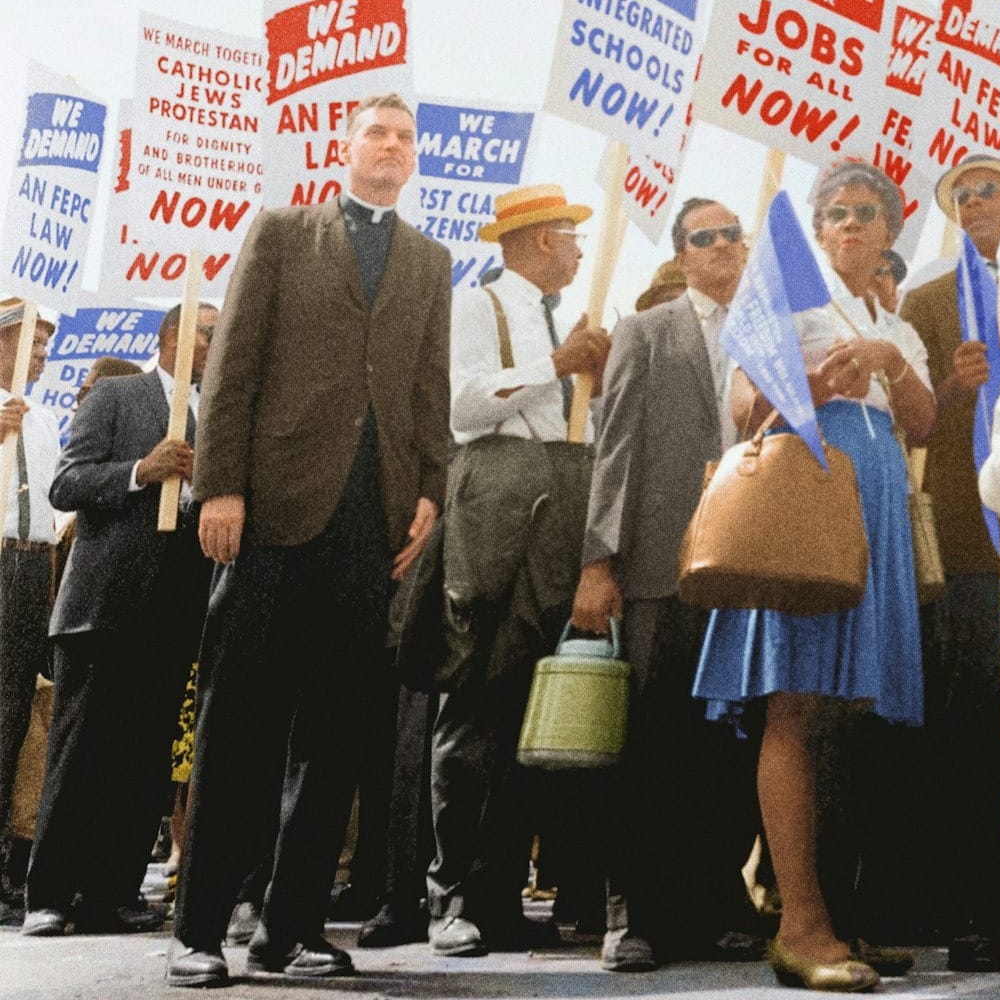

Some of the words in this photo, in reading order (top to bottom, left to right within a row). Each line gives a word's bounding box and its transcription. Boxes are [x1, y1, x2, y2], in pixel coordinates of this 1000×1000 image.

[143, 27, 161, 44] WE
[165, 32, 210, 57] MARCH
[275, 22, 401, 91] DEMAND
[570, 18, 684, 95] SCHOOLS
[736, 38, 792, 77] FOR
[806, 71, 853, 103] ALL
[937, 50, 971, 95] AN
[176, 83, 242, 108] JEWS
[569, 67, 674, 138] NOW!
[51, 98, 84, 128] WE
[149, 97, 259, 133] PROTESTAN
[277, 102, 318, 135] AN
[459, 112, 496, 135] WE
[720, 72, 860, 153] NOW!
[882, 107, 912, 150] FE
[25, 128, 98, 162] DEMAND
[143, 145, 168, 161] AND
[166, 130, 189, 145] FOR
[196, 137, 252, 155] DIGNITY
[306, 139, 345, 170] LA
[417, 131, 521, 164] MARCH
[138, 163, 150, 176] OF
[156, 168, 173, 181] ALL
[178, 172, 202, 187] MEN
[207, 177, 247, 192] UNDER
[444, 163, 485, 178] FOR
[19, 173, 46, 206] AN
[50, 184, 91, 224] FEPC
[149, 189, 264, 232] NOW
[457, 192, 496, 216] CLA
[30, 212, 73, 251] LAW
[416, 216, 482, 242] ZENS
[11, 245, 78, 293] NOW!
[96, 311, 142, 331] WE
